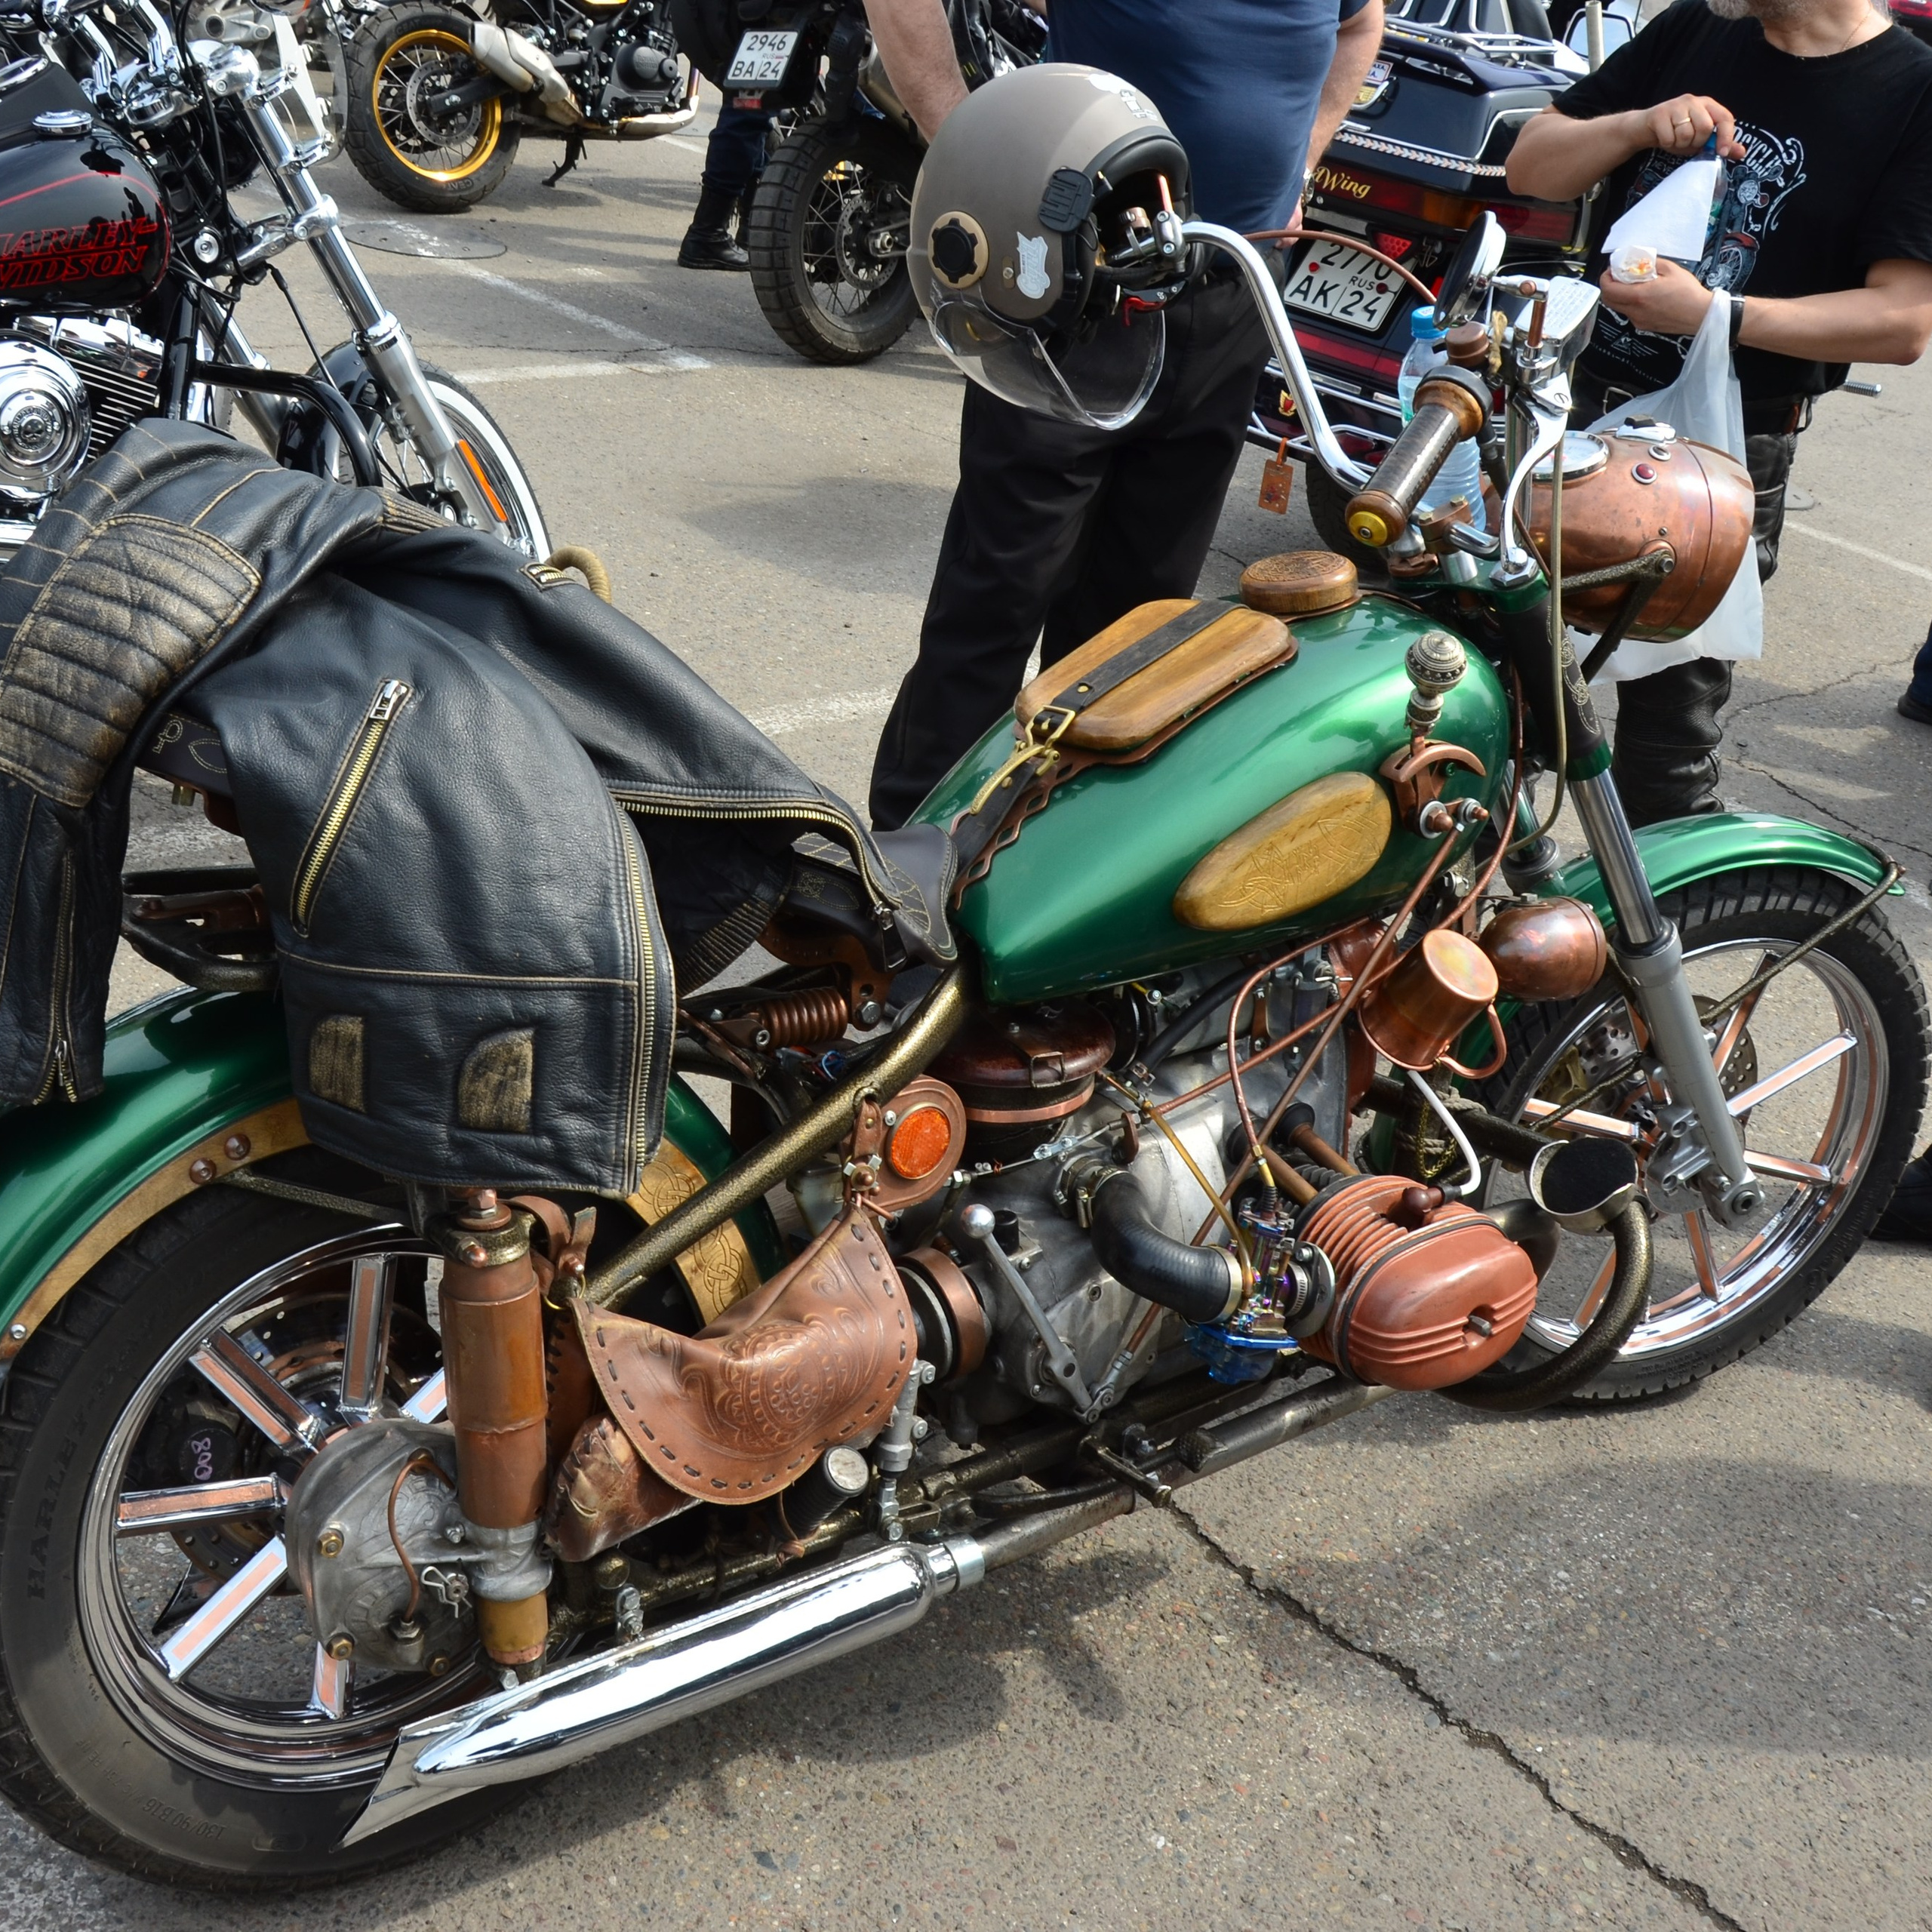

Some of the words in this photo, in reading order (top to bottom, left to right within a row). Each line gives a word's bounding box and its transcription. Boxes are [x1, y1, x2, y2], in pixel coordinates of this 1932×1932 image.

[746, 35, 788, 51] 2946
[731, 61, 755, 78] BA
[759, 61, 781, 78] 24
[1349, 275, 1375, 291] RUS
[1289, 275, 1340, 308] AK
[1340, 290, 1382, 322] 24
